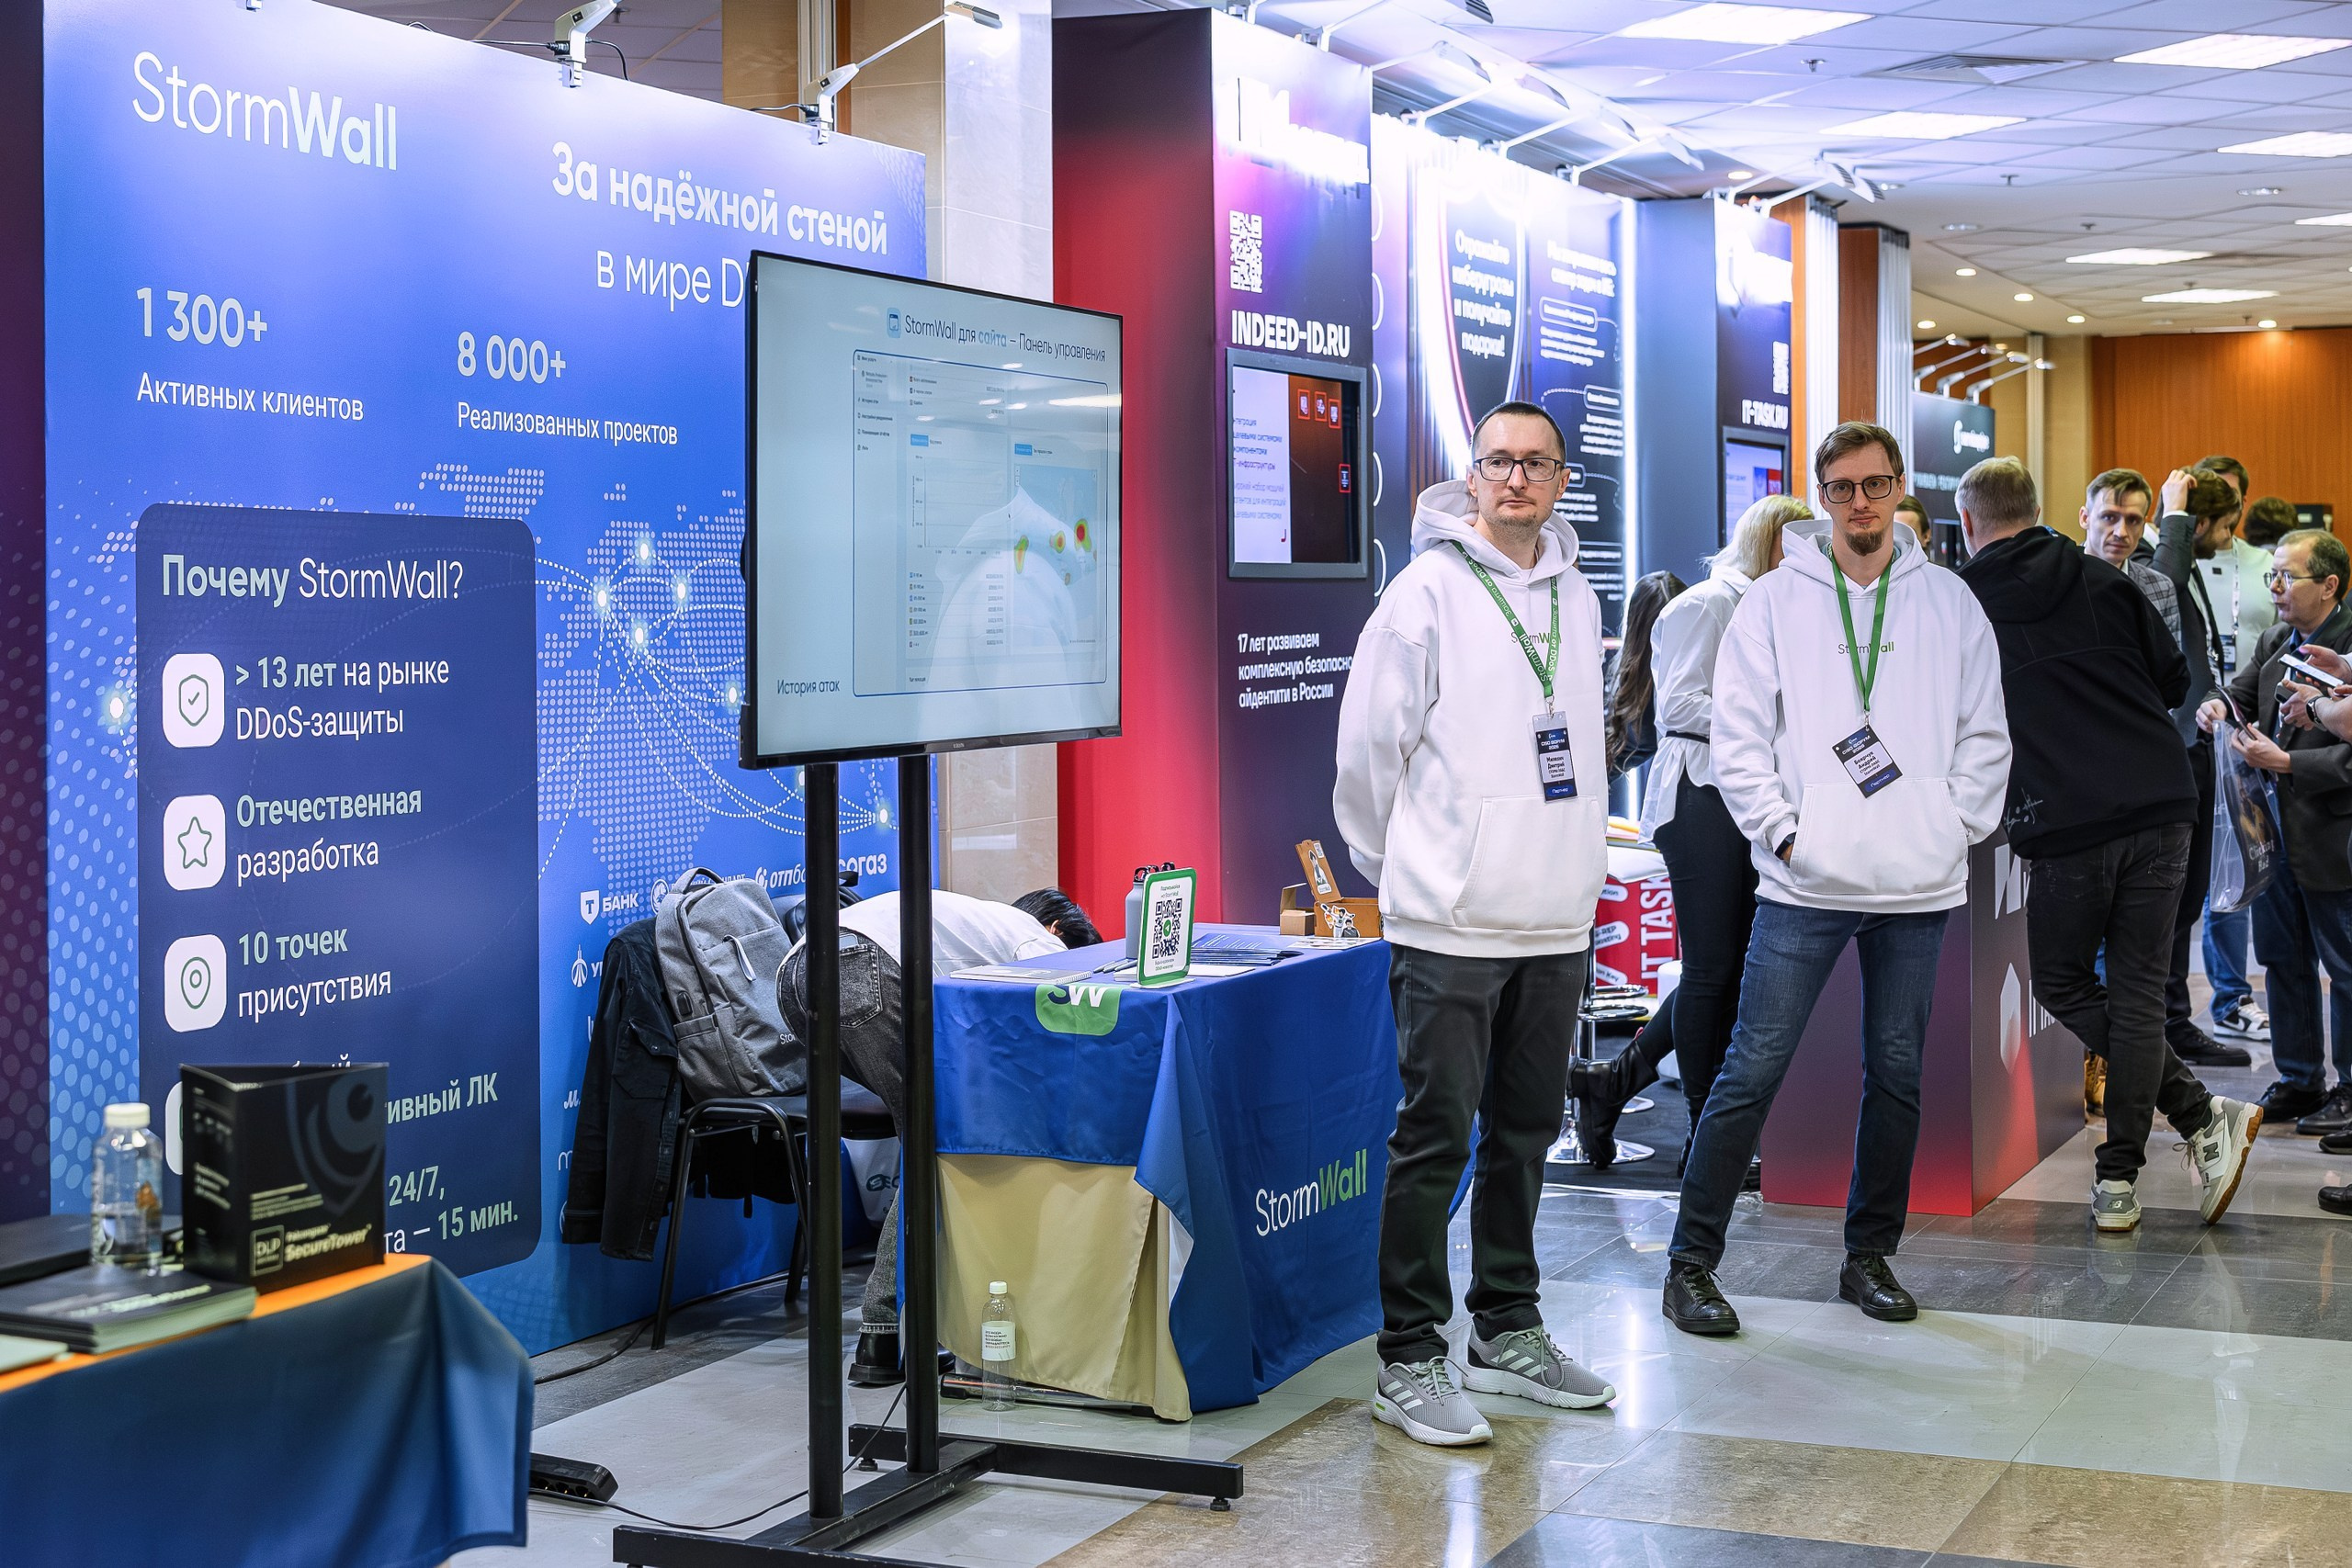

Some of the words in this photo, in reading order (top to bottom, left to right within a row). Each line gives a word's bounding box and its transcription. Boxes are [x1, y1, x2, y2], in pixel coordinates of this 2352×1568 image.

[132, 51, 398, 171] StormWall
[551, 141, 597, 200] За
[609, 168, 779, 236] надёжной
[786, 203, 888, 255] стеной
[626, 254, 711, 311] мире
[136, 288, 153, 337] 1
[166, 291, 268, 348] 300+
[904, 314, 956, 341] StormWall
[958, 326, 977, 344] для
[978, 330, 1008, 347] сайта
[1019, 333, 1053, 355] Панель
[1055, 343, 1106, 363] управления
[1230, 309, 1351, 359] INDEED-ID.RU
[458, 331, 476, 377] 8
[486, 334, 567, 383] 000+
[137, 372, 256, 412] Активных
[262, 390, 364, 422] клиентов
[458, 402, 600, 440] Реализованных
[603, 421, 678, 446] проектов
[162, 554, 289, 607] Почему
[299, 557, 464, 600] StormWall?
[1237, 633, 1249, 653] 17
[1249, 636, 1266, 653] лет
[1266, 632, 1320, 656] развиваем
[258, 657, 288, 689] 13
[294, 662, 337, 688] лет
[344, 662, 371, 686] на
[379, 659, 449, 694] рынке
[776, 679, 818, 697] История
[819, 680, 841, 694] атак
[1238, 660, 1304, 681] комплексную
[1305, 655, 1353, 674] безопасно
[1238, 687, 1291, 709] айдентити
[1291, 687, 1298, 703] в
[1299, 682, 1334, 701] России
[235, 706, 404, 741] DDoS-защиты
[236, 789, 423, 828] Отечественная
[236, 837, 379, 887] разработка
[602, 892, 639, 913] БАНК
[1640, 875, 1673, 946] TASK
[238, 931, 269, 966] 10
[276, 926, 348, 960] точек
[237, 970, 392, 1022] присутствия
[467, 1072, 498, 1108] ЛК
[388, 1165, 446, 1207] 24/7,
[1255, 1148, 1367, 1236] StormWall
[438, 1206, 464, 1240] 15
[469, 1201, 518, 1233] мин.
